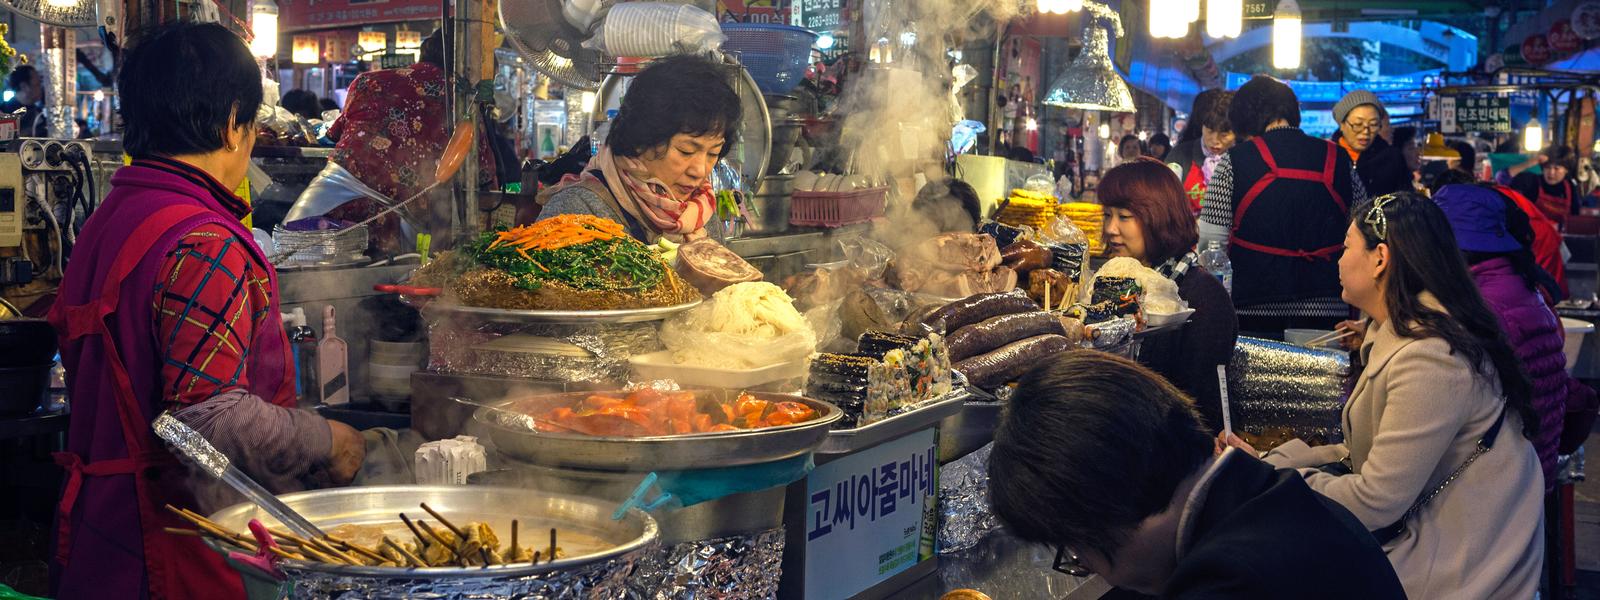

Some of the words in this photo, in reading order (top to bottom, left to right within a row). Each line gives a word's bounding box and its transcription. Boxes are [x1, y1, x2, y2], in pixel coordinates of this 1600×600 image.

[1245, 3, 1266, 13] 7567
[1457, 107, 1509, 122] 원조빈대떡
[808, 446, 935, 542] 고씨아줌마네
